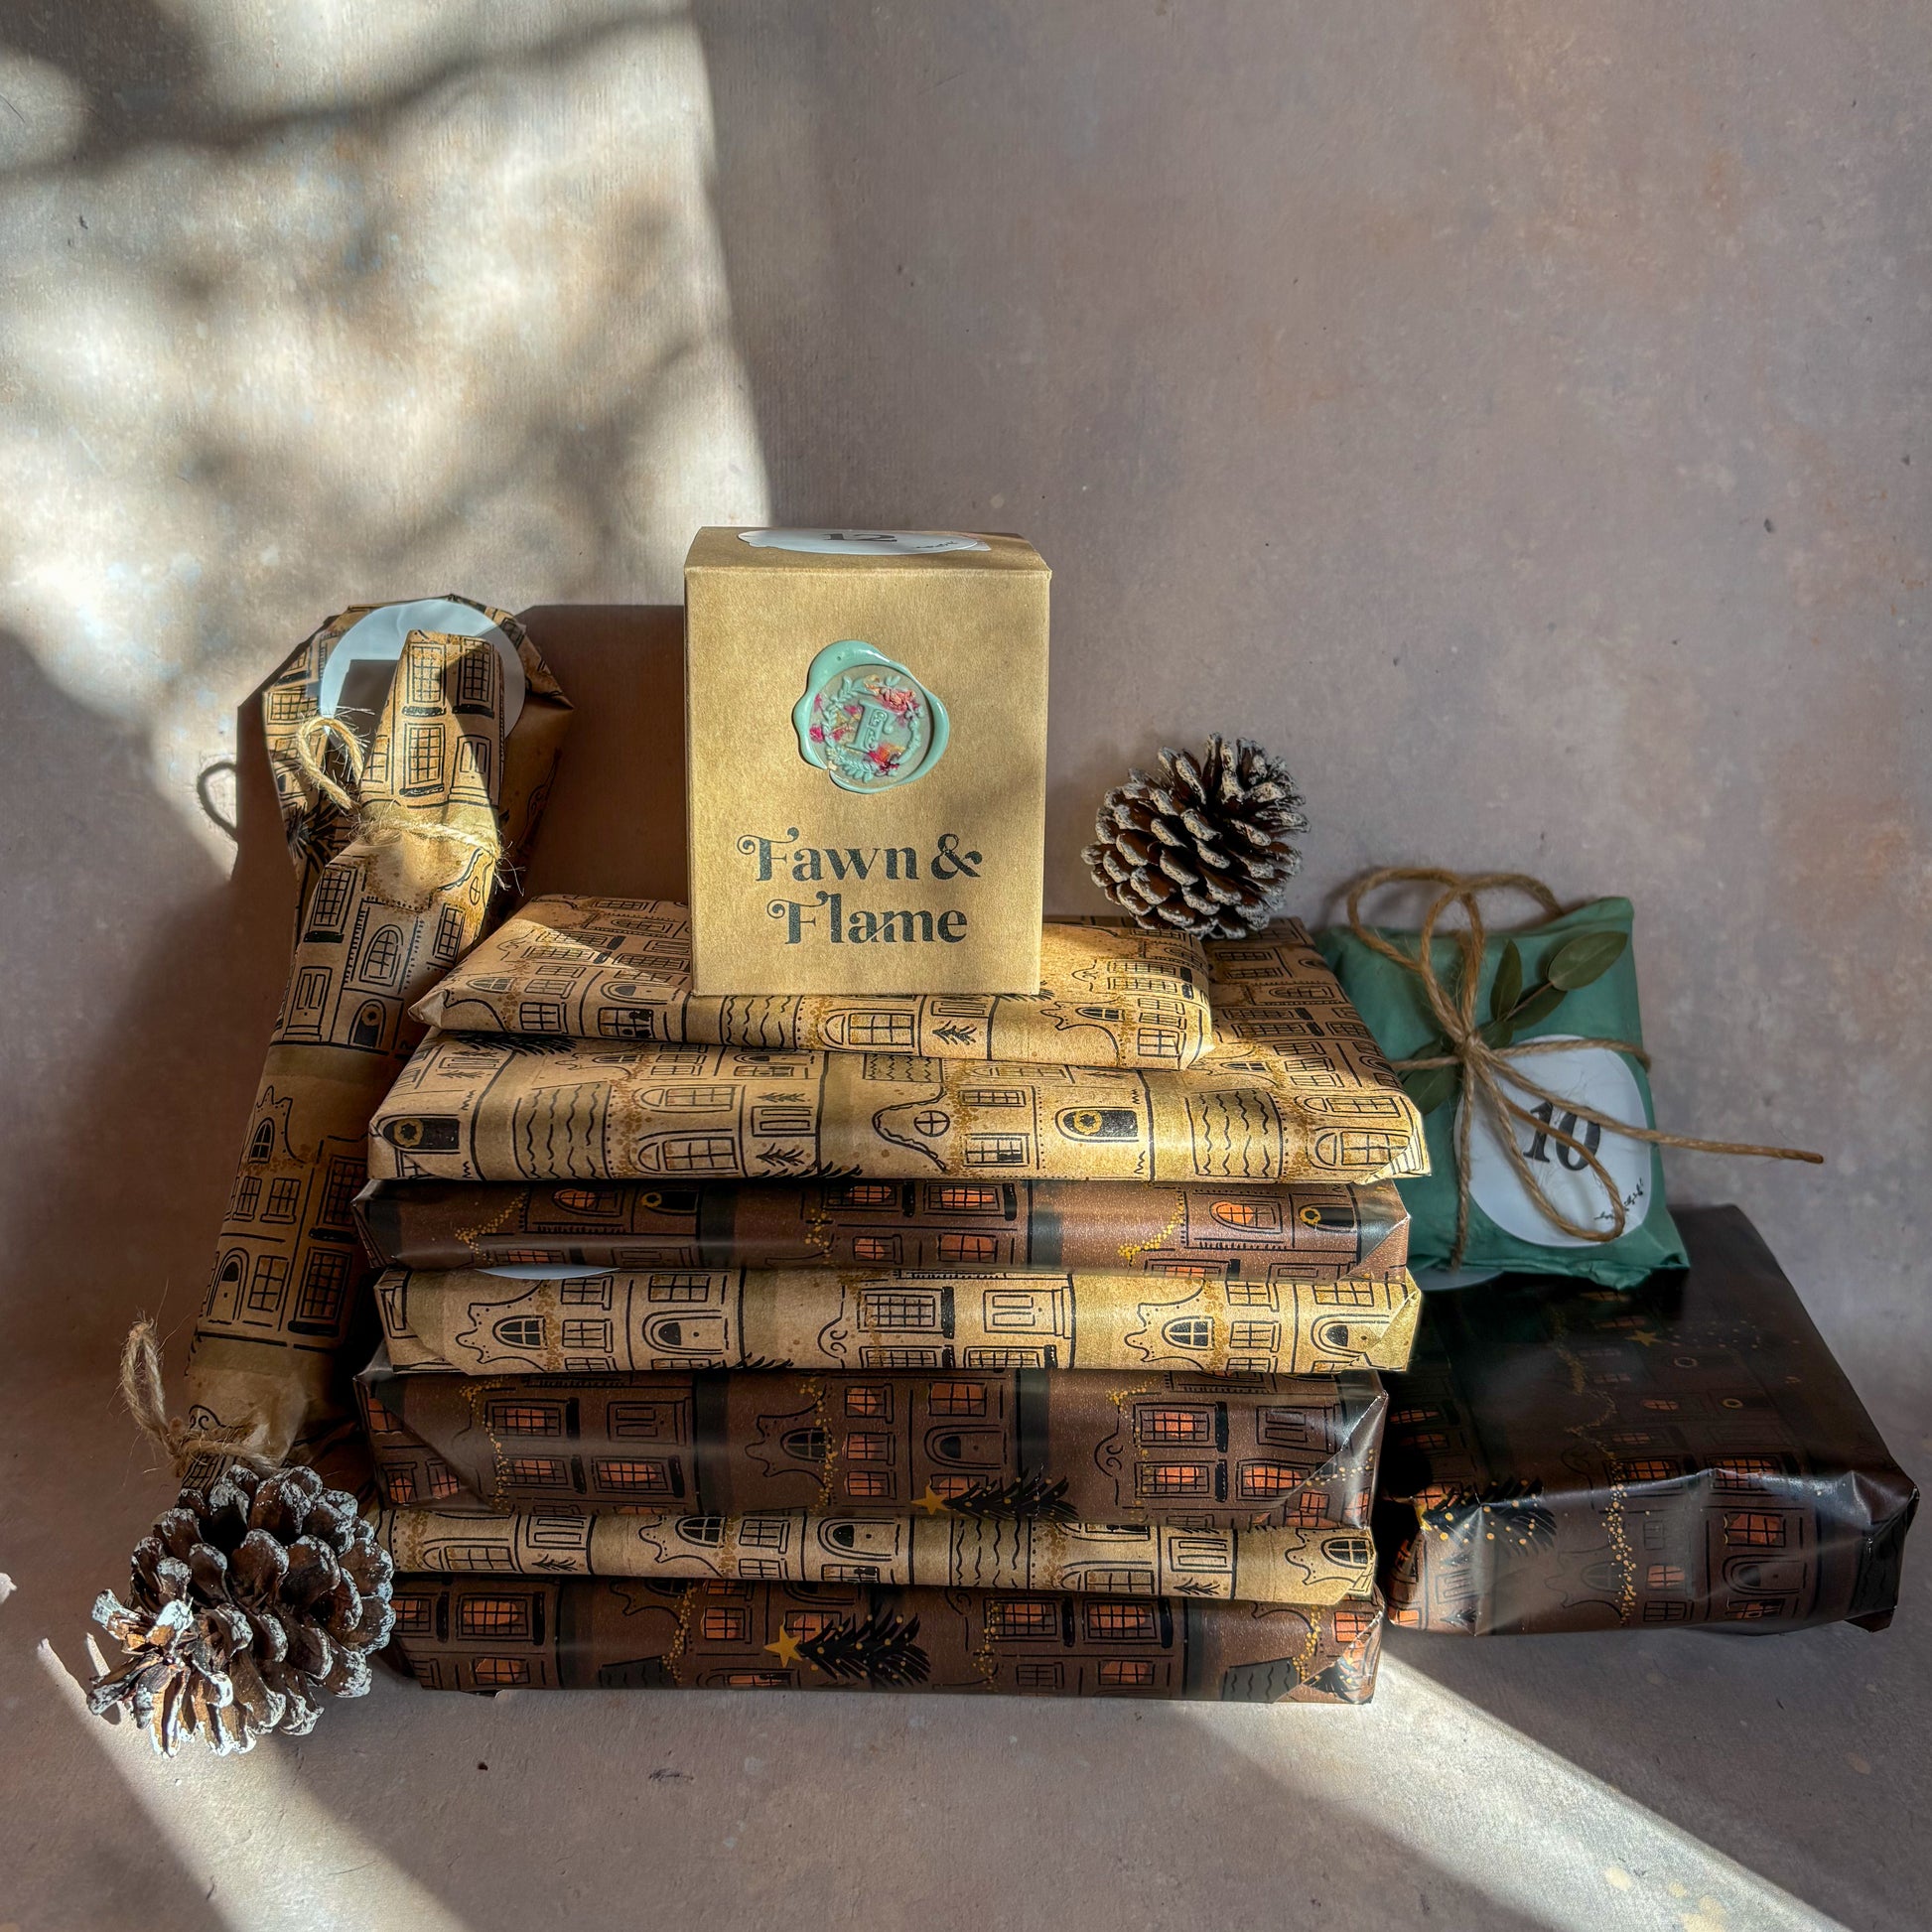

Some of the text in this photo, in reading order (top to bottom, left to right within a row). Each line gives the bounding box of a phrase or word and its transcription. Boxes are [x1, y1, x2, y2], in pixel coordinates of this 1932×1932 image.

[820, 532, 898, 543] 12
[737, 826, 983, 883] Fawn &
[766, 891, 968, 945] Flame
[1523, 1101, 1601, 1172] 10
